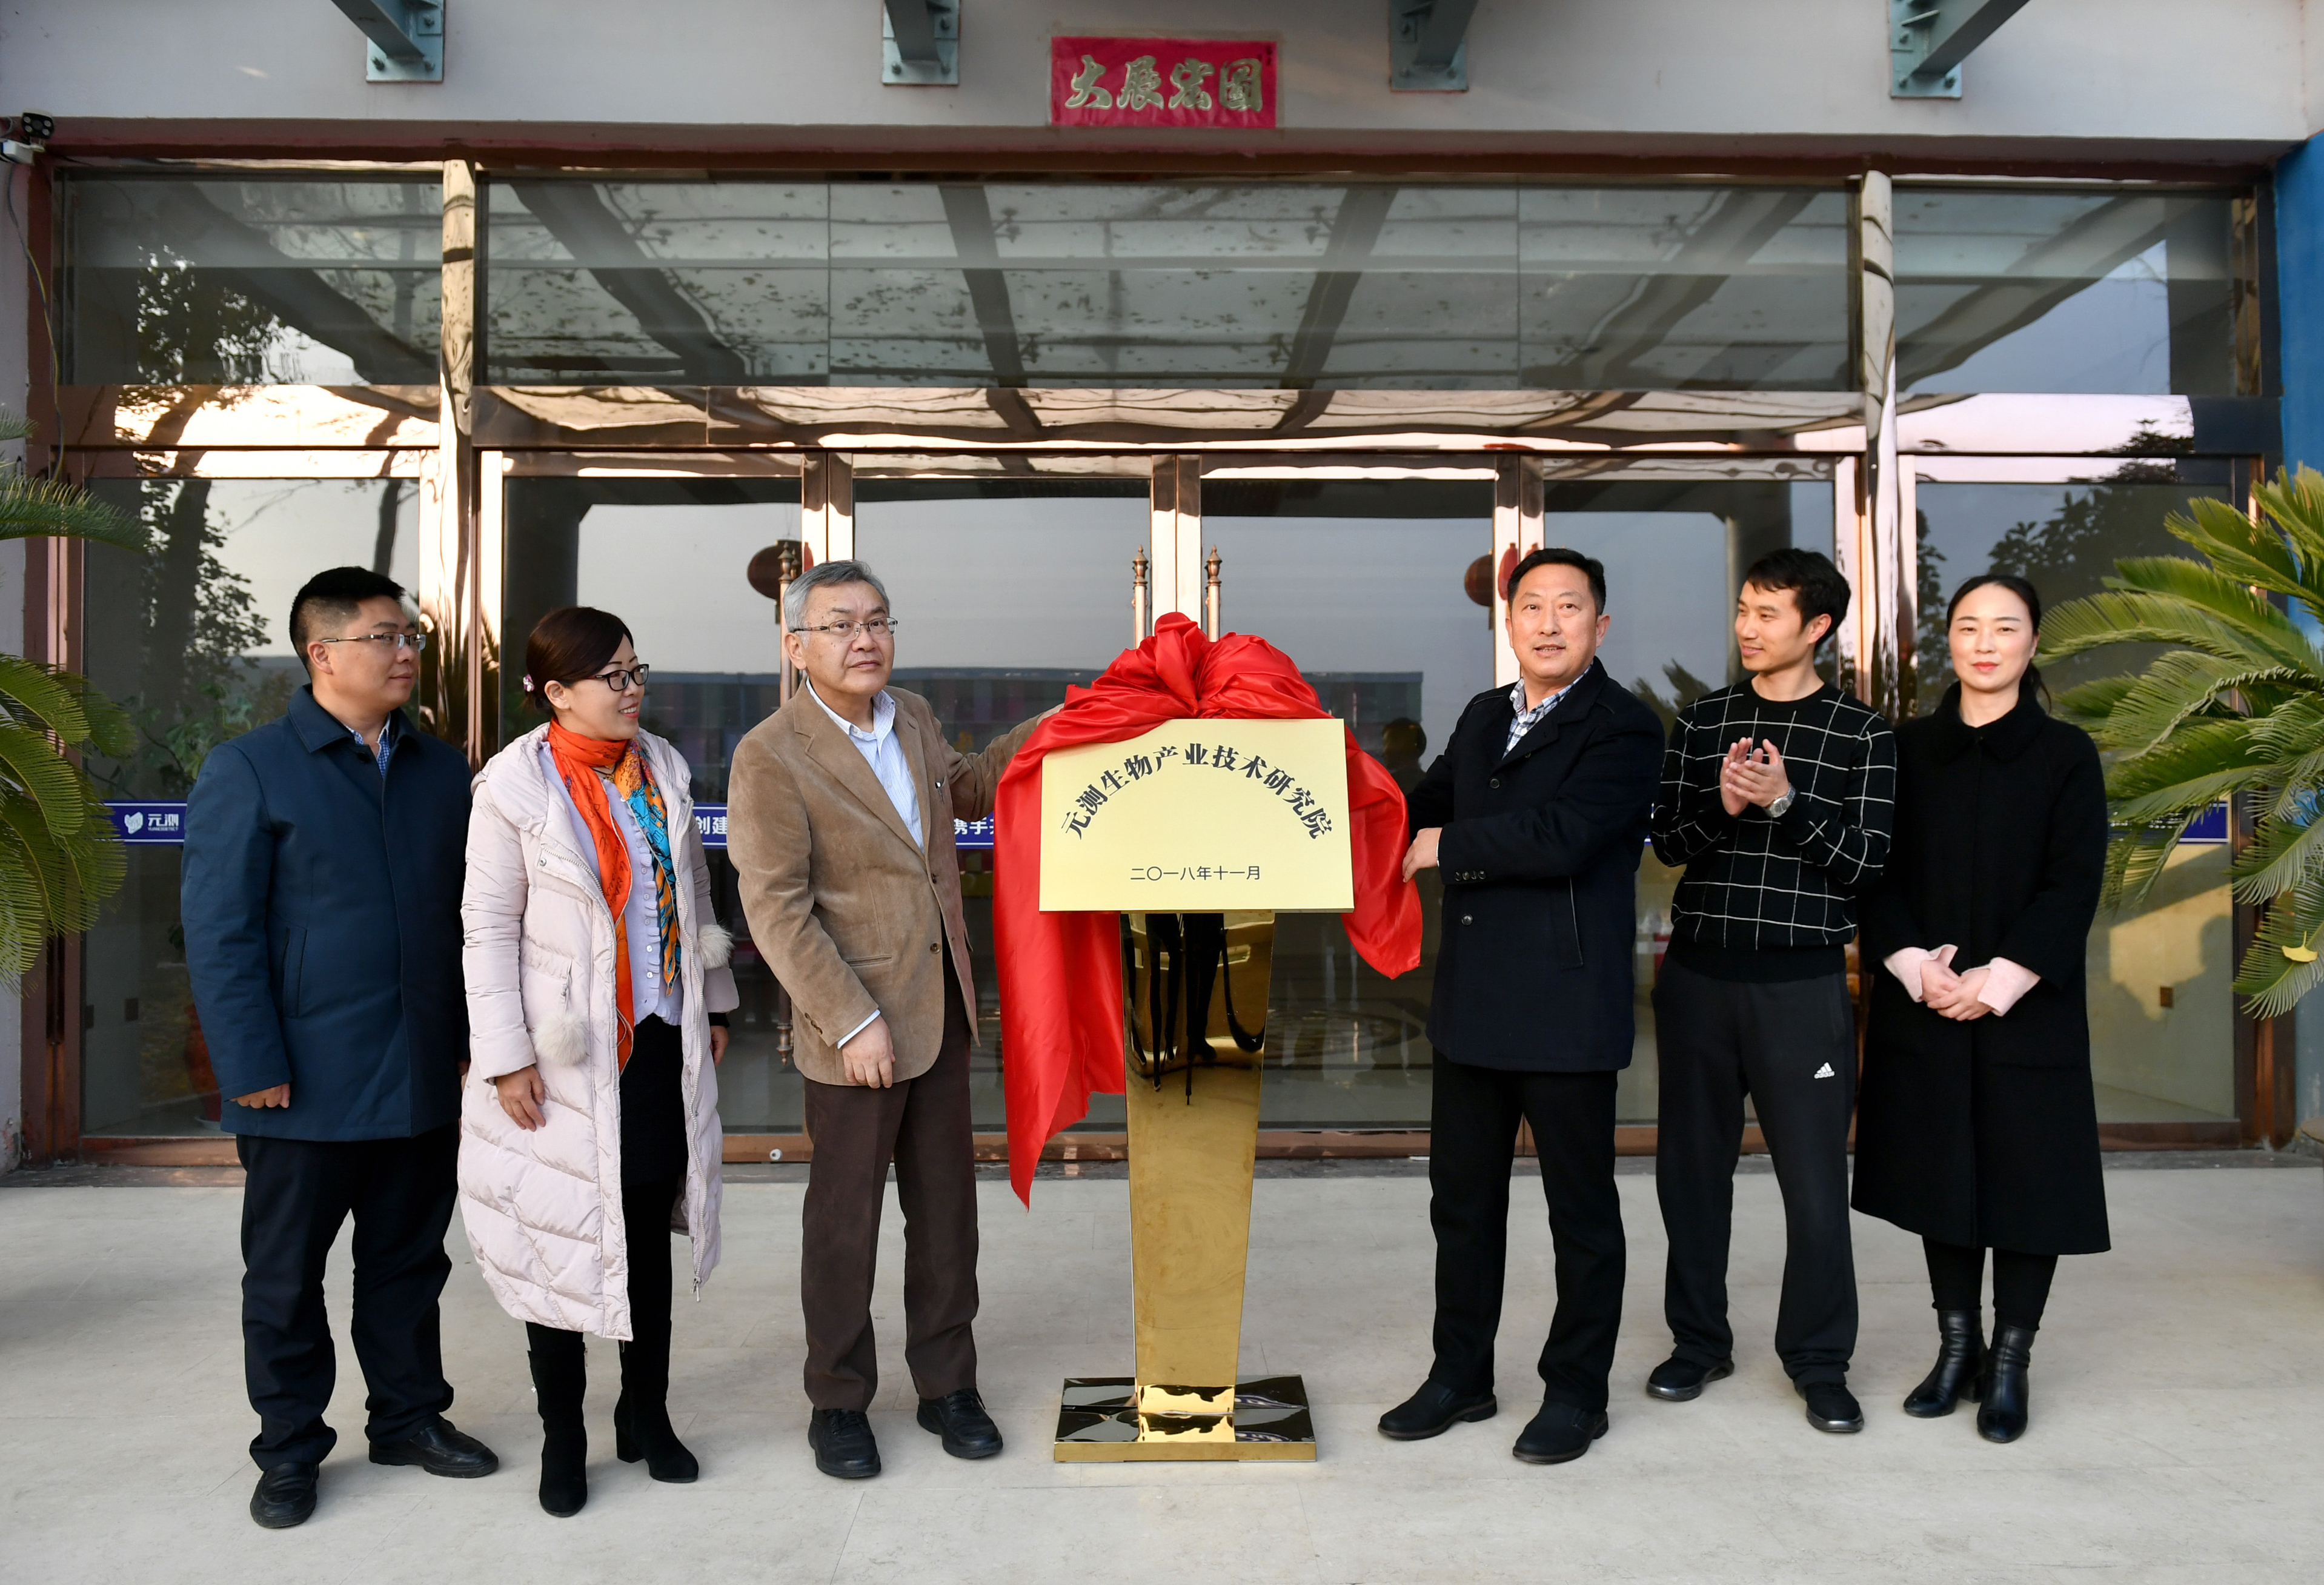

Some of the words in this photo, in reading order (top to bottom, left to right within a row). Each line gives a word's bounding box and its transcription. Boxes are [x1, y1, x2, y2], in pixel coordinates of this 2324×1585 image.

[1061, 743, 1332, 840] 元测生物产业技术研究院
